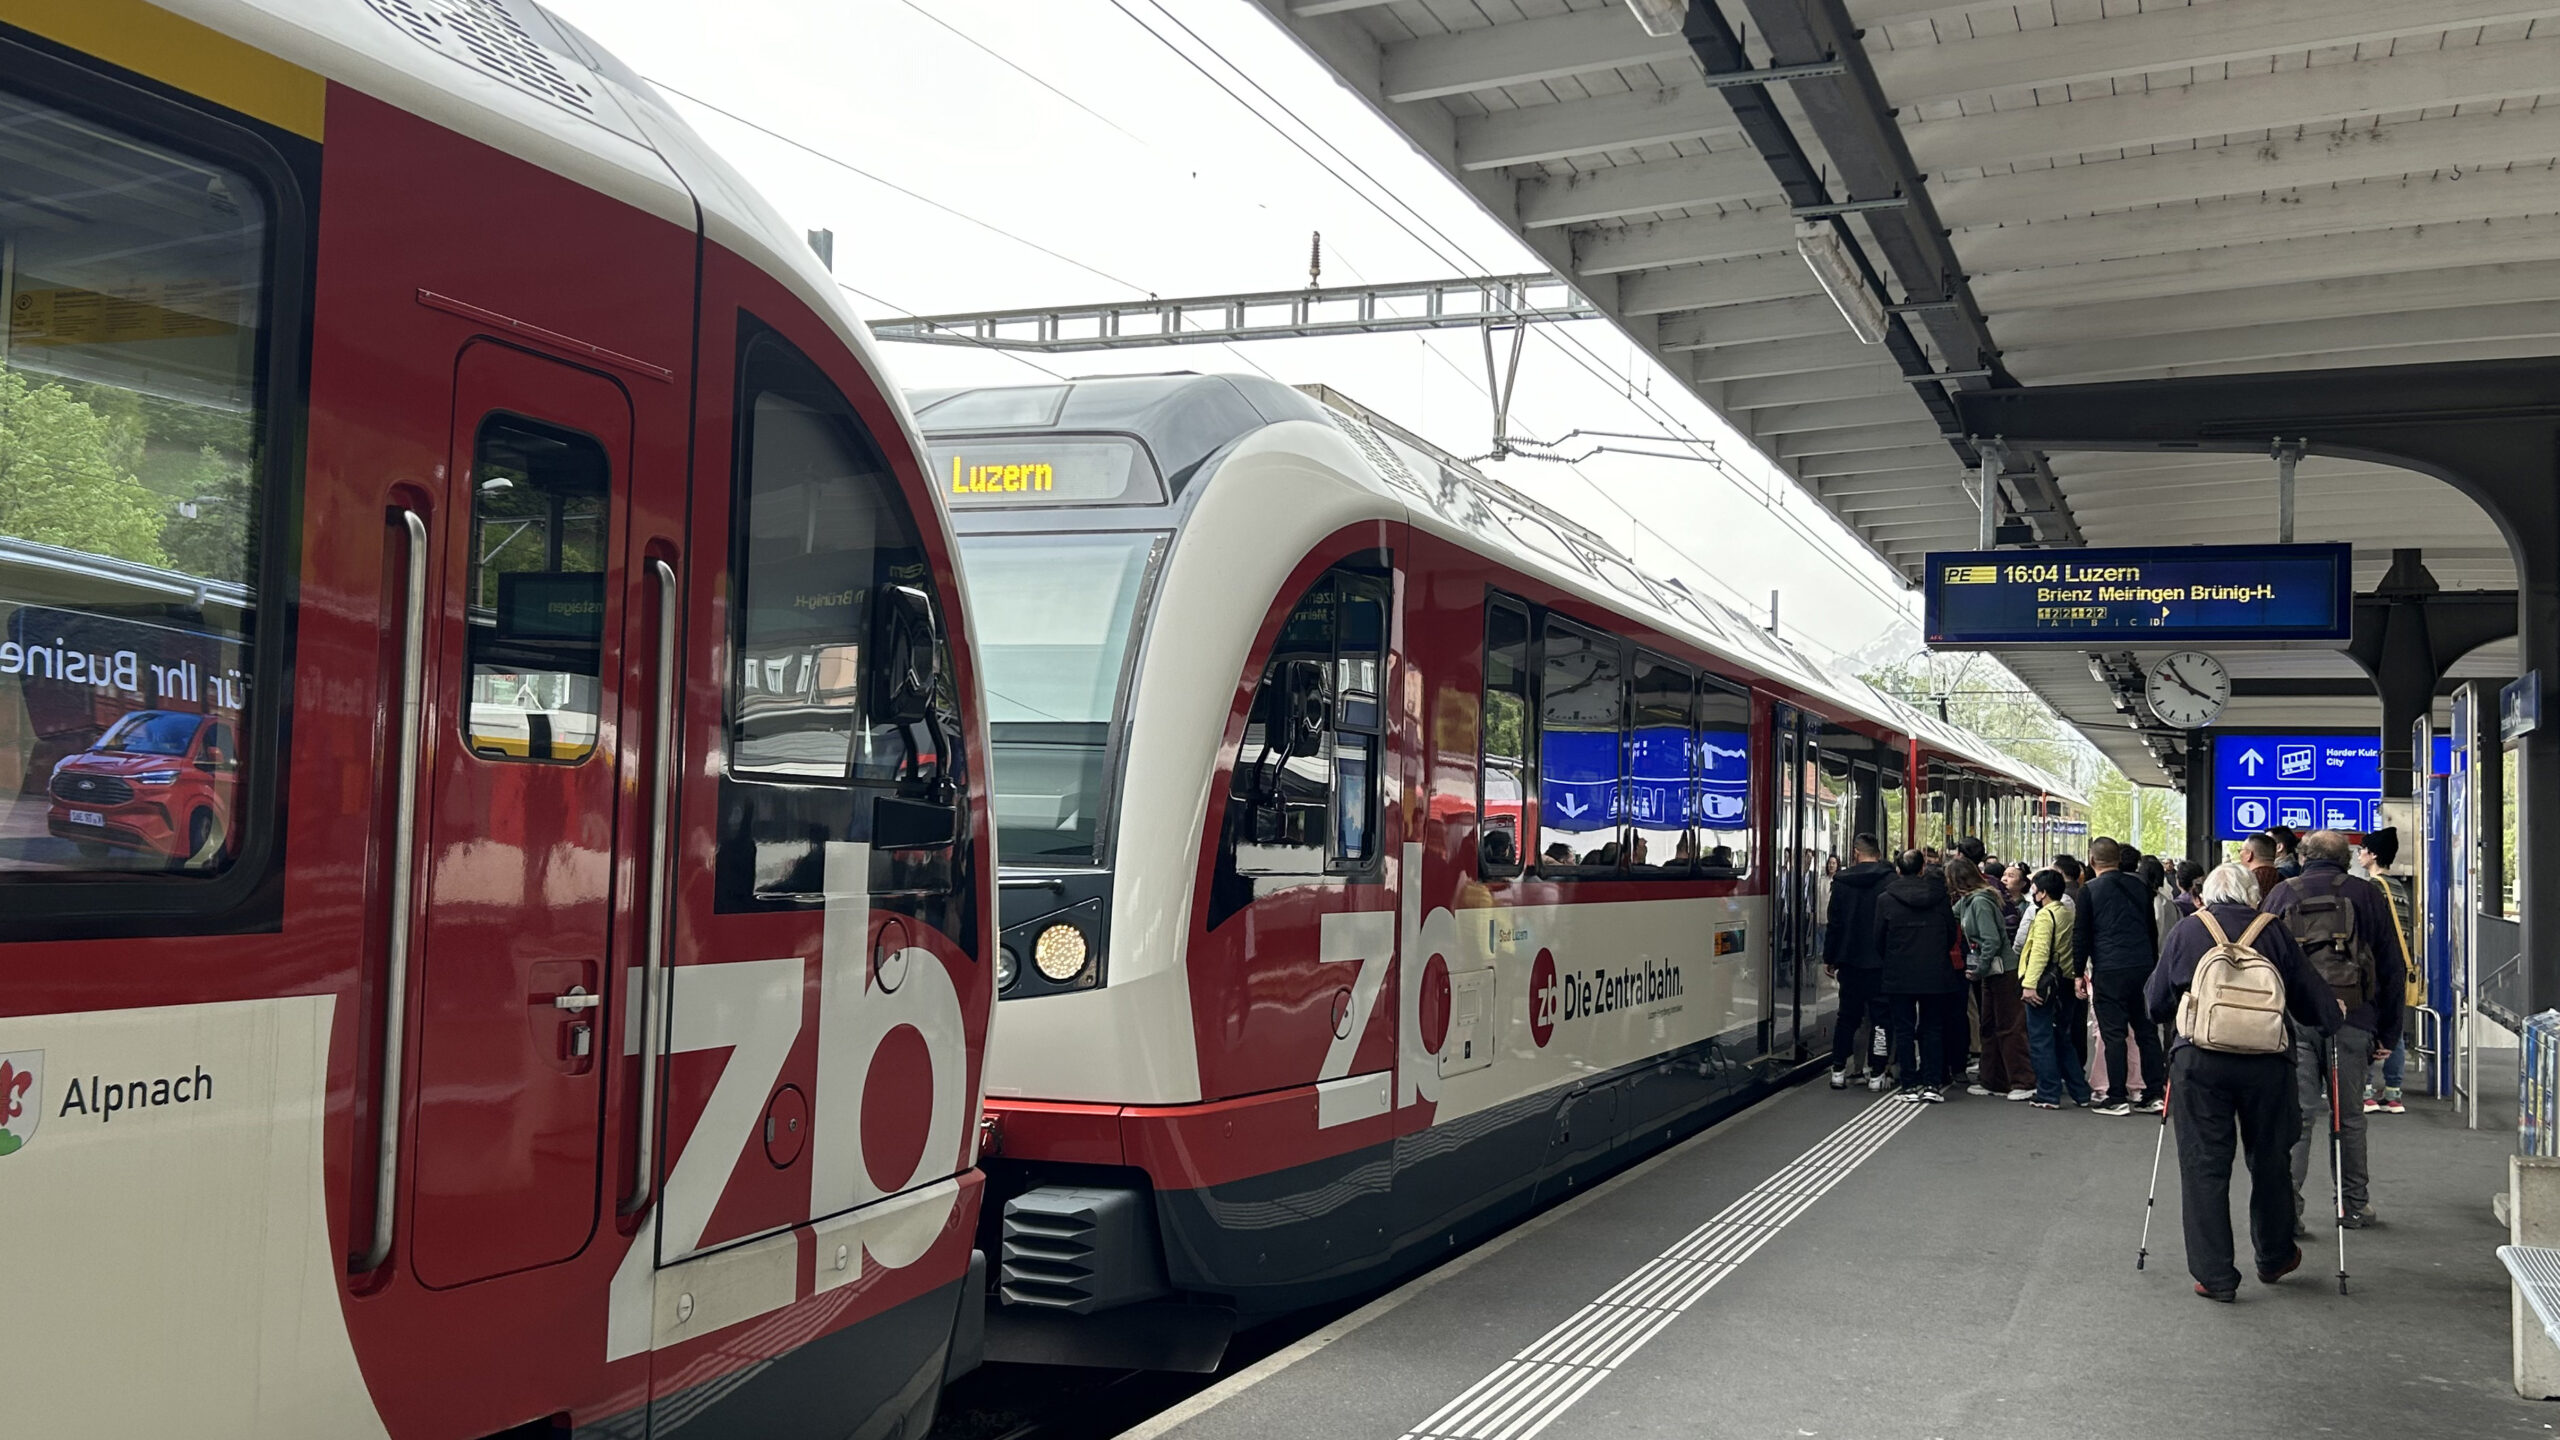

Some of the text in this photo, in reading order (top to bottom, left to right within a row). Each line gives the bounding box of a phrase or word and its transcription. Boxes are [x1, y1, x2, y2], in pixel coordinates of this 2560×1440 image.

[951, 456, 1053, 494] Luzern
[2003, 564, 2059, 583] 16:04
[2064, 564, 2141, 583] Luzern
[2037, 584, 2275, 604] Brienz Meiringen Brünig-H.
[2325, 748, 2357, 757] Harder
[2325, 757, 2345, 768] City
[1317, 842, 1458, 1130] zb
[1563, 957, 1683, 1021] Die Zentralbahn.
[1873, 1025, 1888, 1056] JORDAN
[59, 1064, 213, 1122] Alpnach
[606, 841, 967, 1362] zb
